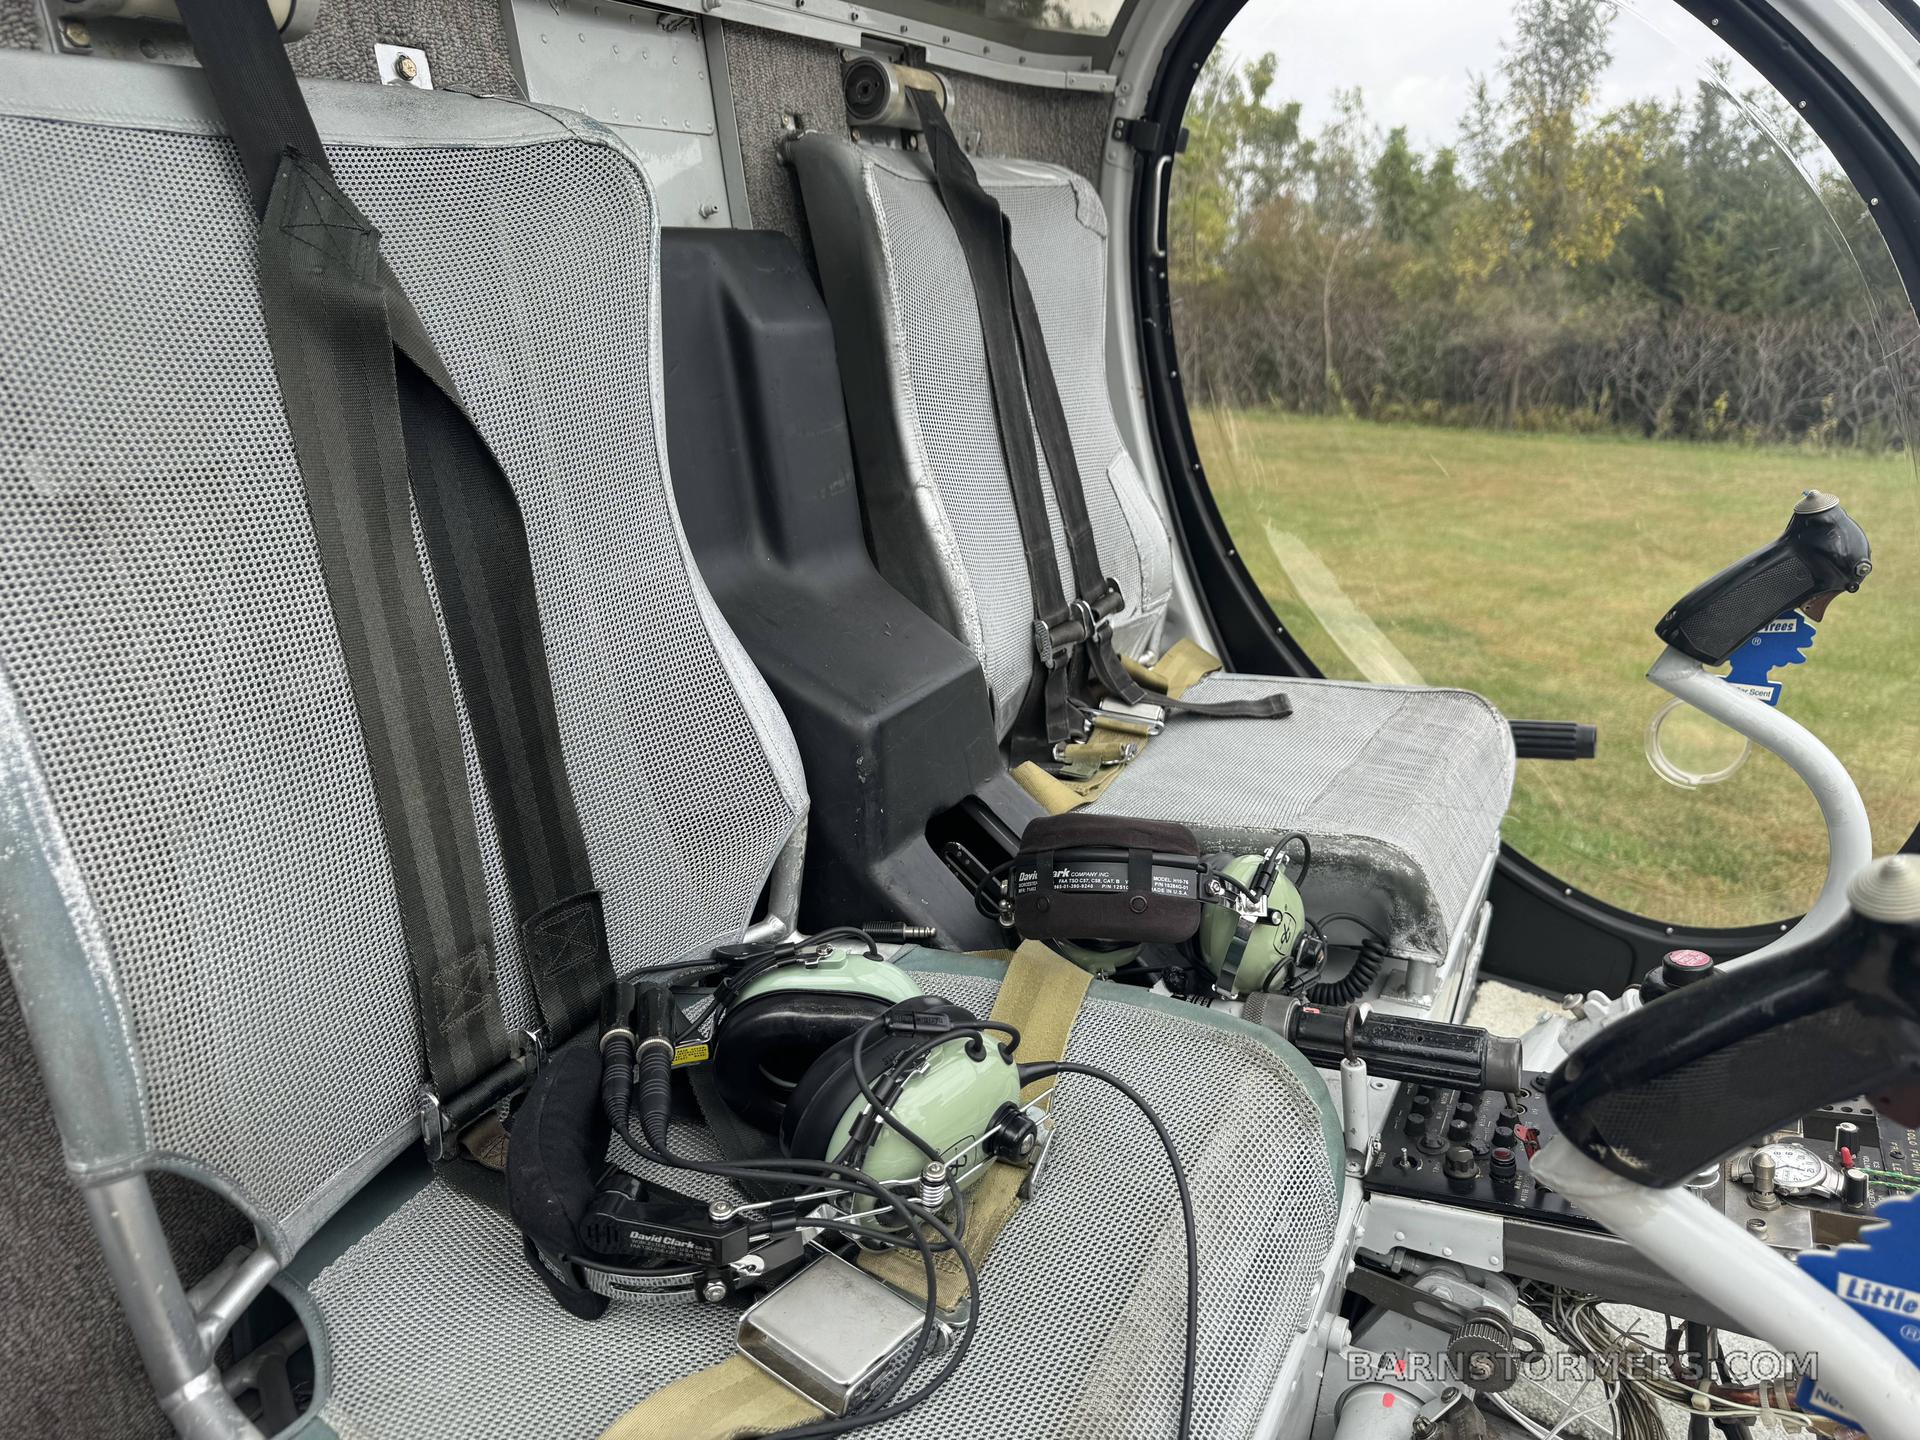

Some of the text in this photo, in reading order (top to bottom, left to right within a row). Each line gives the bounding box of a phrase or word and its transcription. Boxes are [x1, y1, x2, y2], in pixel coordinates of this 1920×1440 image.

[1749, 688, 1771, 698] Scent
[1053, 868, 1070, 878] ark
[1907, 1129, 1918, 1146] SOLO
[629, 1231, 662, 1243] David
[662, 1236, 695, 1249] Clark
[1846, 1278, 1919, 1314] Little
[1816, 1388, 1845, 1409] Ne
